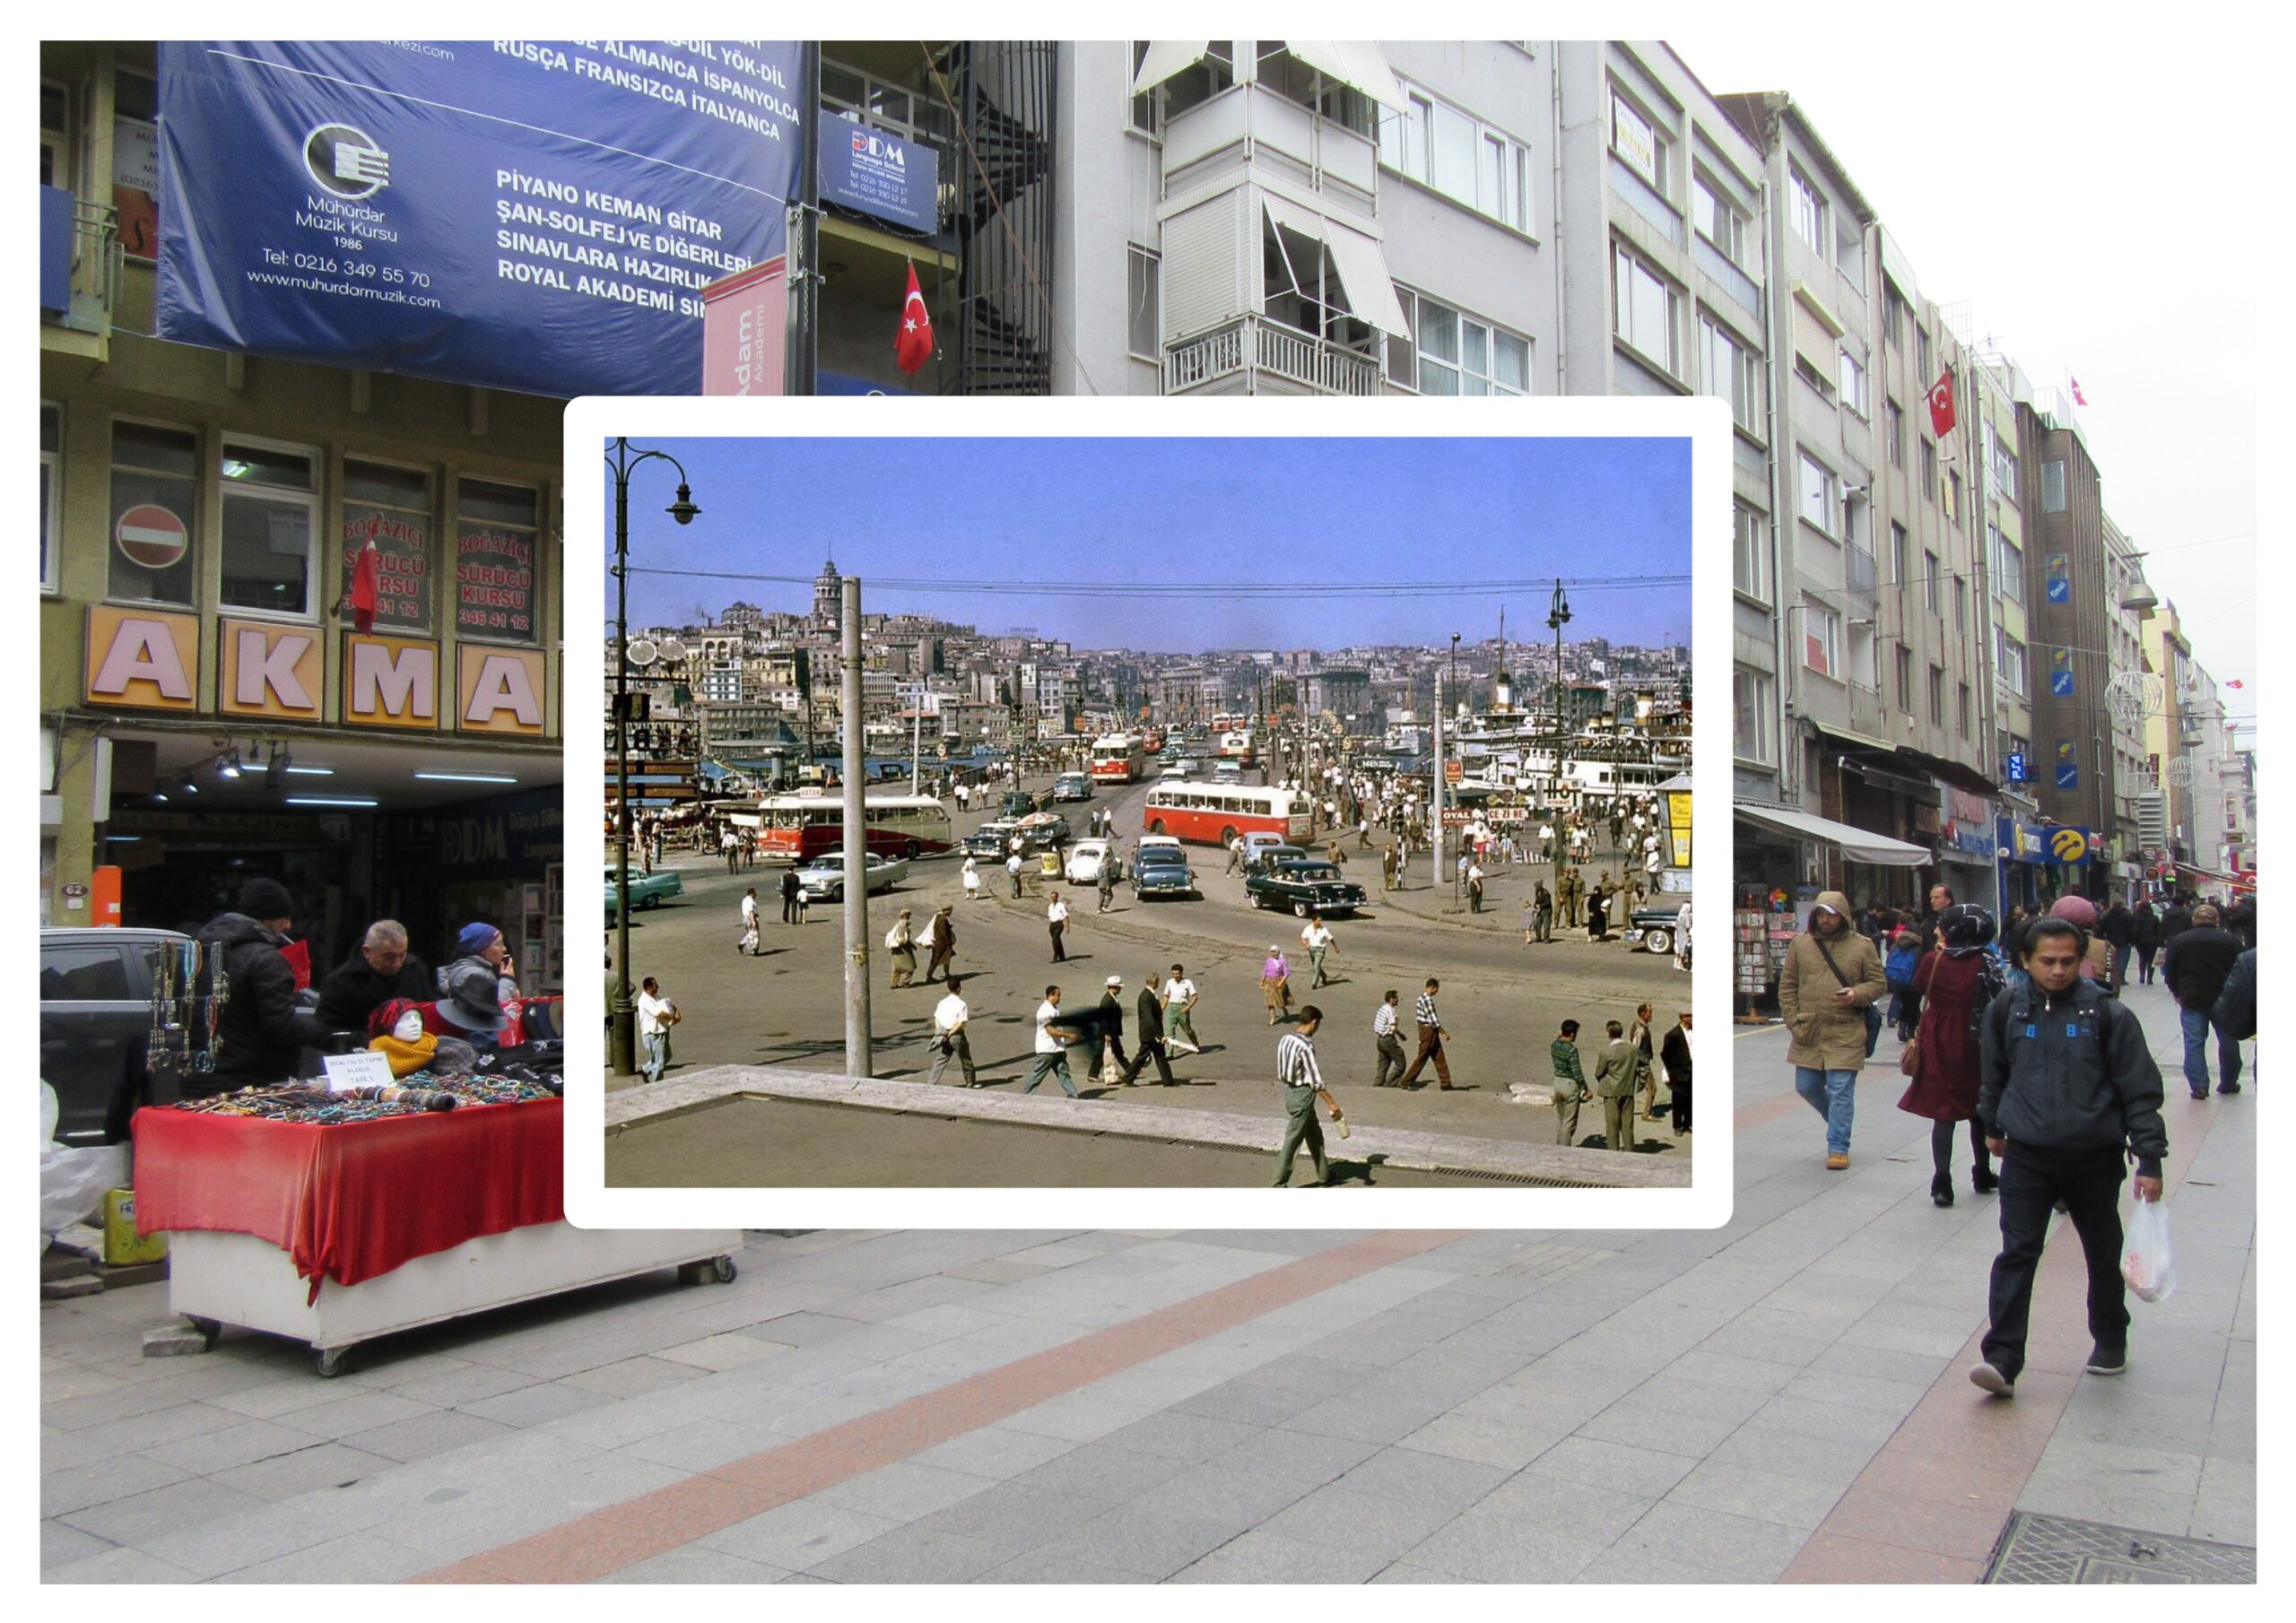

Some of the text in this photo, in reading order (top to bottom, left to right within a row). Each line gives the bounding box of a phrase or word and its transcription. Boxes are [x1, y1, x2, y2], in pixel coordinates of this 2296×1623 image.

[604, 40, 801, 126] ALMANCA İSPANYOLCA
[721, 48, 787, 90] YÖK-DİL
[493, 40, 780, 142] RUSÇA FRANSIZCA İTALYANCA
[852, 130, 905, 166] DDM
[852, 150, 906, 175] Language School
[308, 195, 386, 223] Mühürdar
[497, 169, 722, 240] PİYANO KEMAN GİTAR
[296, 211, 398, 242] Müzik Kursu
[497, 199, 753, 273] ŞAN-SOLFEJ VE DİĞERLERİ
[334, 237, 363, 251] 1986
[497, 230, 619, 272] SINAVLARA
[263, 247, 430, 287] Tel: 0216 349 55 70
[247, 271, 441, 308] www.muhurdarmuzik.com
[498, 259, 570, 291] ROYAL
[577, 275, 674, 311] AKADEMİ
[754, 304, 765, 382] Akademi
[344, 549, 425, 576] SRÜCÜ
[457, 529, 533, 567] BOĞAZİÇİ
[350, 572, 419, 596] RSU
[457, 562, 532, 588] SÜRÜCÜ
[399, 602, 419, 617] 12
[462, 586, 526, 609] KURSU
[459, 609, 529, 630] 346 41 12
[2011, 755, 2022, 779] PS4
[1443, 812, 1469, 820] OYAL
[66, 885, 83, 895] 62
